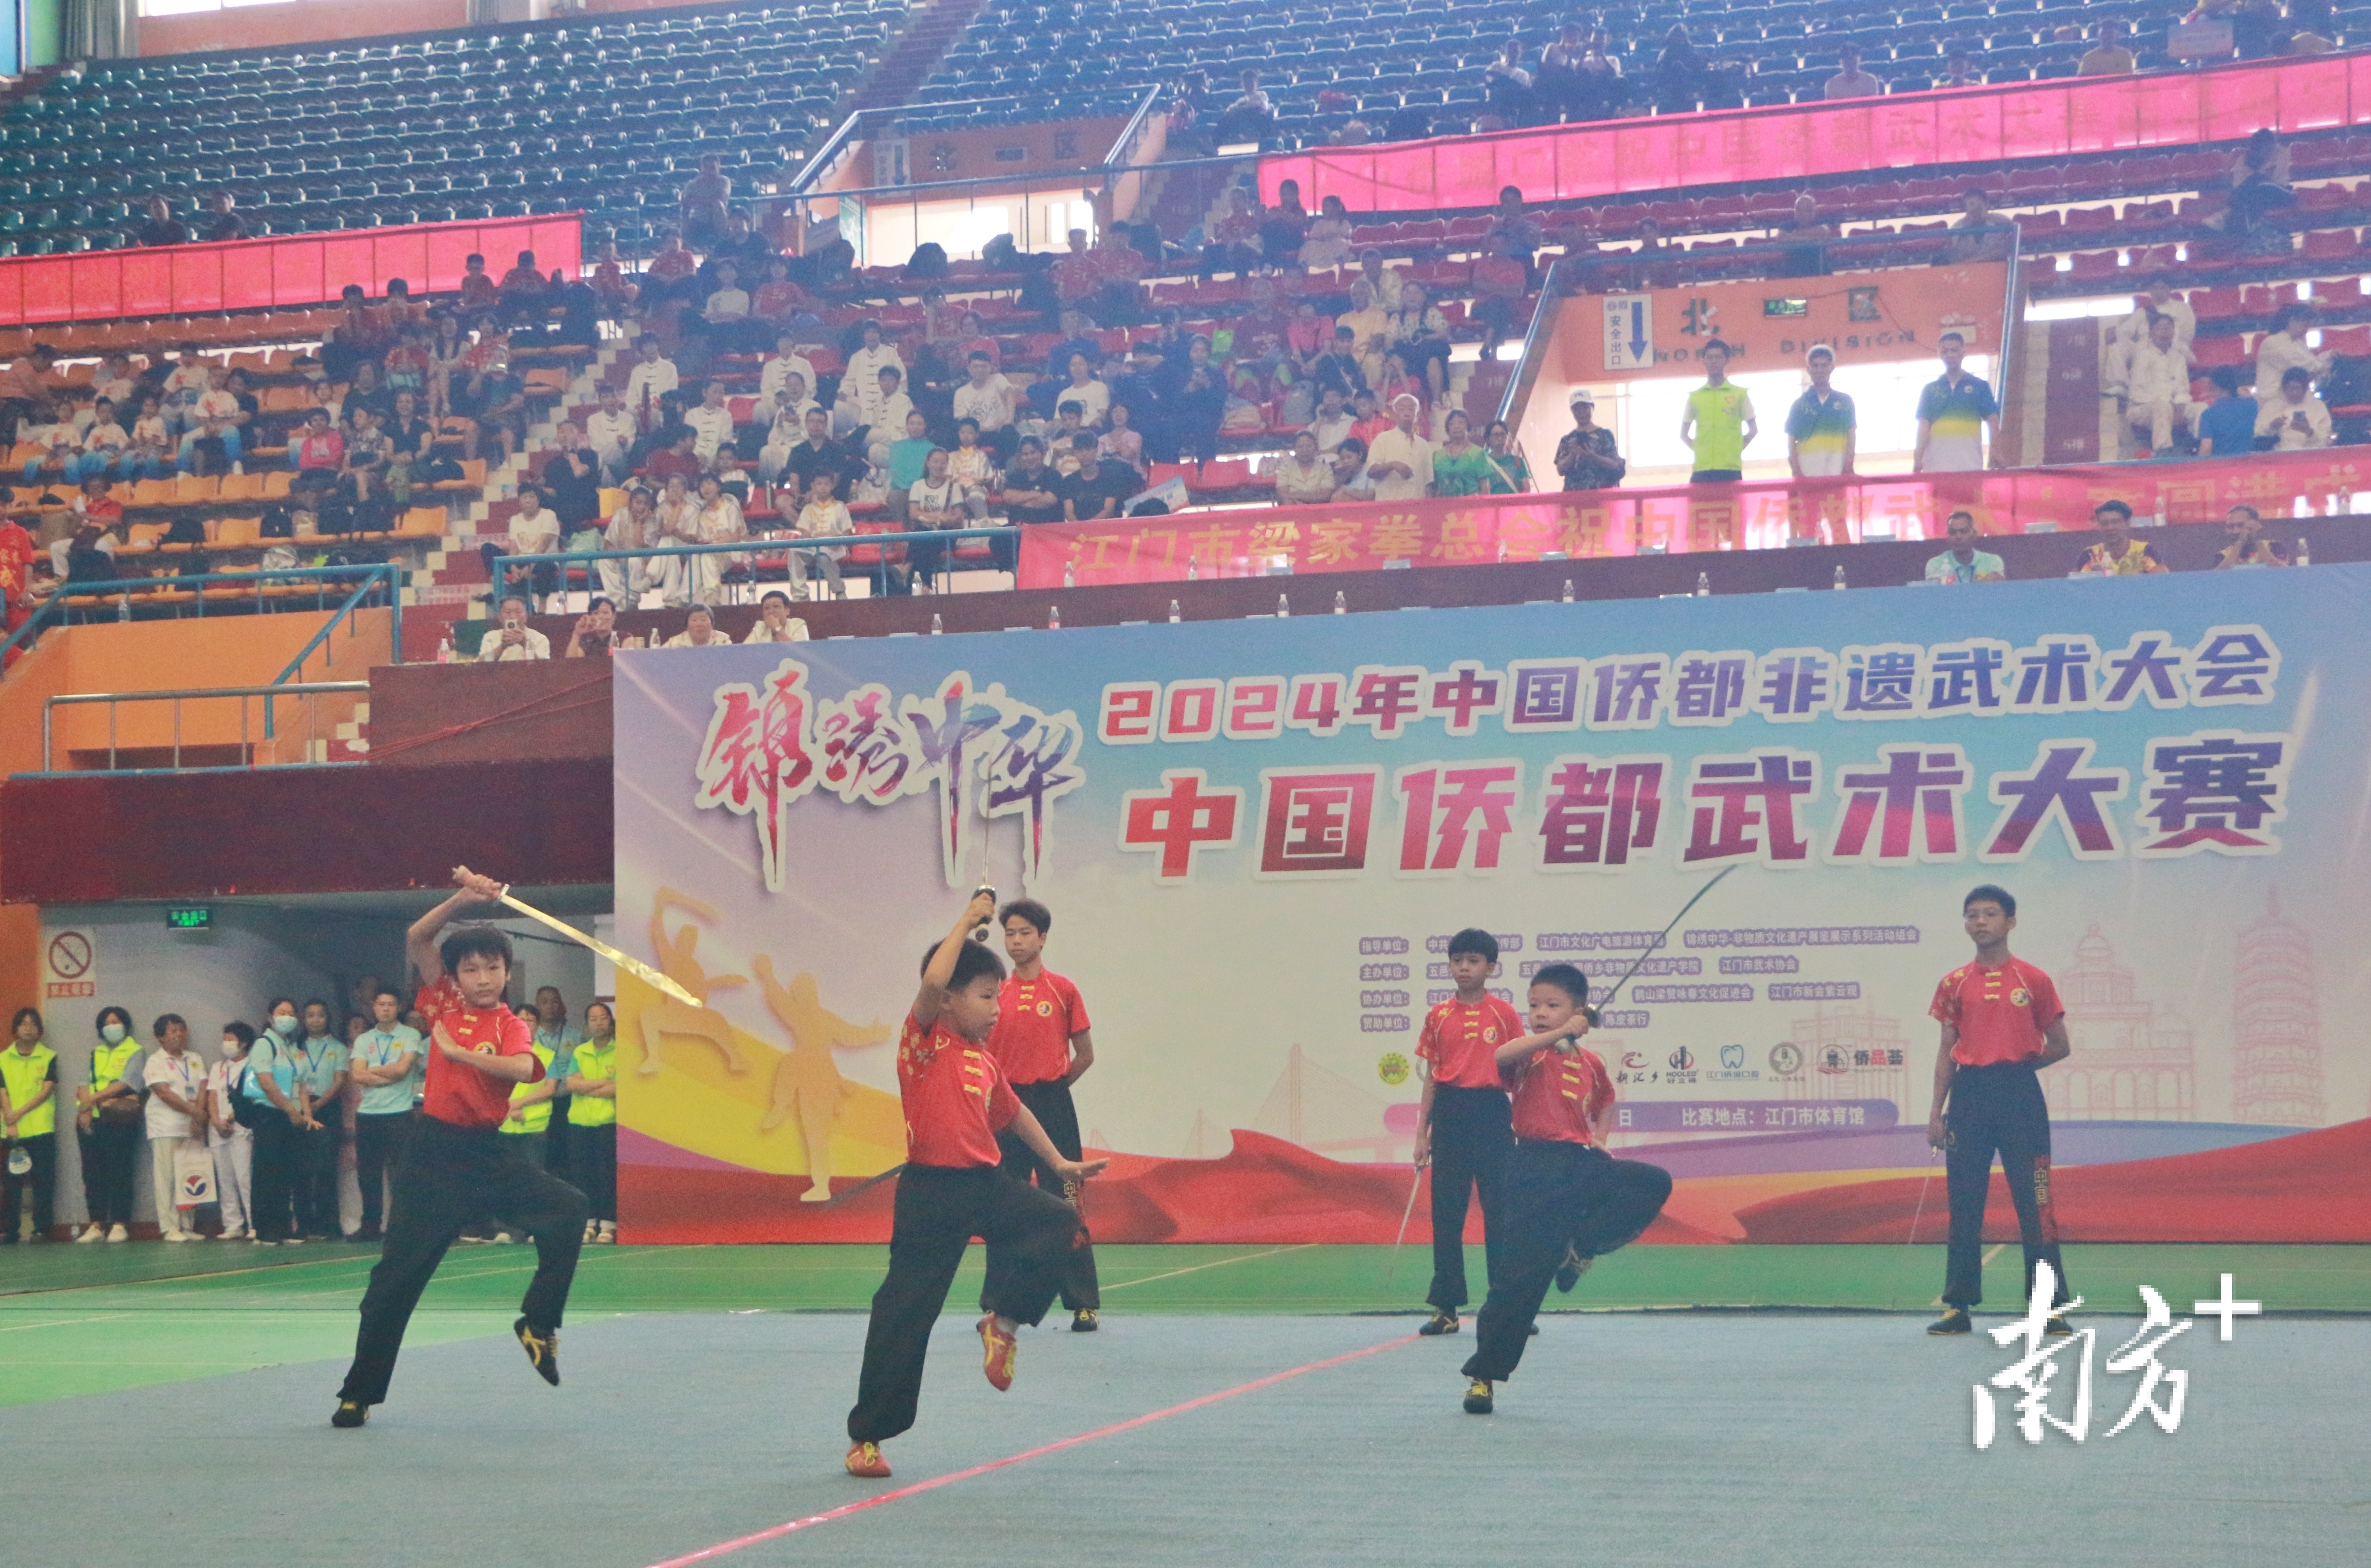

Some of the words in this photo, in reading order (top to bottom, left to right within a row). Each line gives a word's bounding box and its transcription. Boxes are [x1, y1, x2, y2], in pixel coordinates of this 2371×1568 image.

[1610, 315, 1621, 365] 安全出口
[1681, 298, 1720, 336] 北
[1106, 633, 2272, 737] 2024年中国侨都非遗武术大会
[704, 670, 1076, 883] 锦绣中华
[1124, 738, 2284, 878] 中国侨都武术大赛
[1722, 958, 1797, 971] 江门市武术协会
[1605, 1013, 1647, 1025] 陈皮茶行
